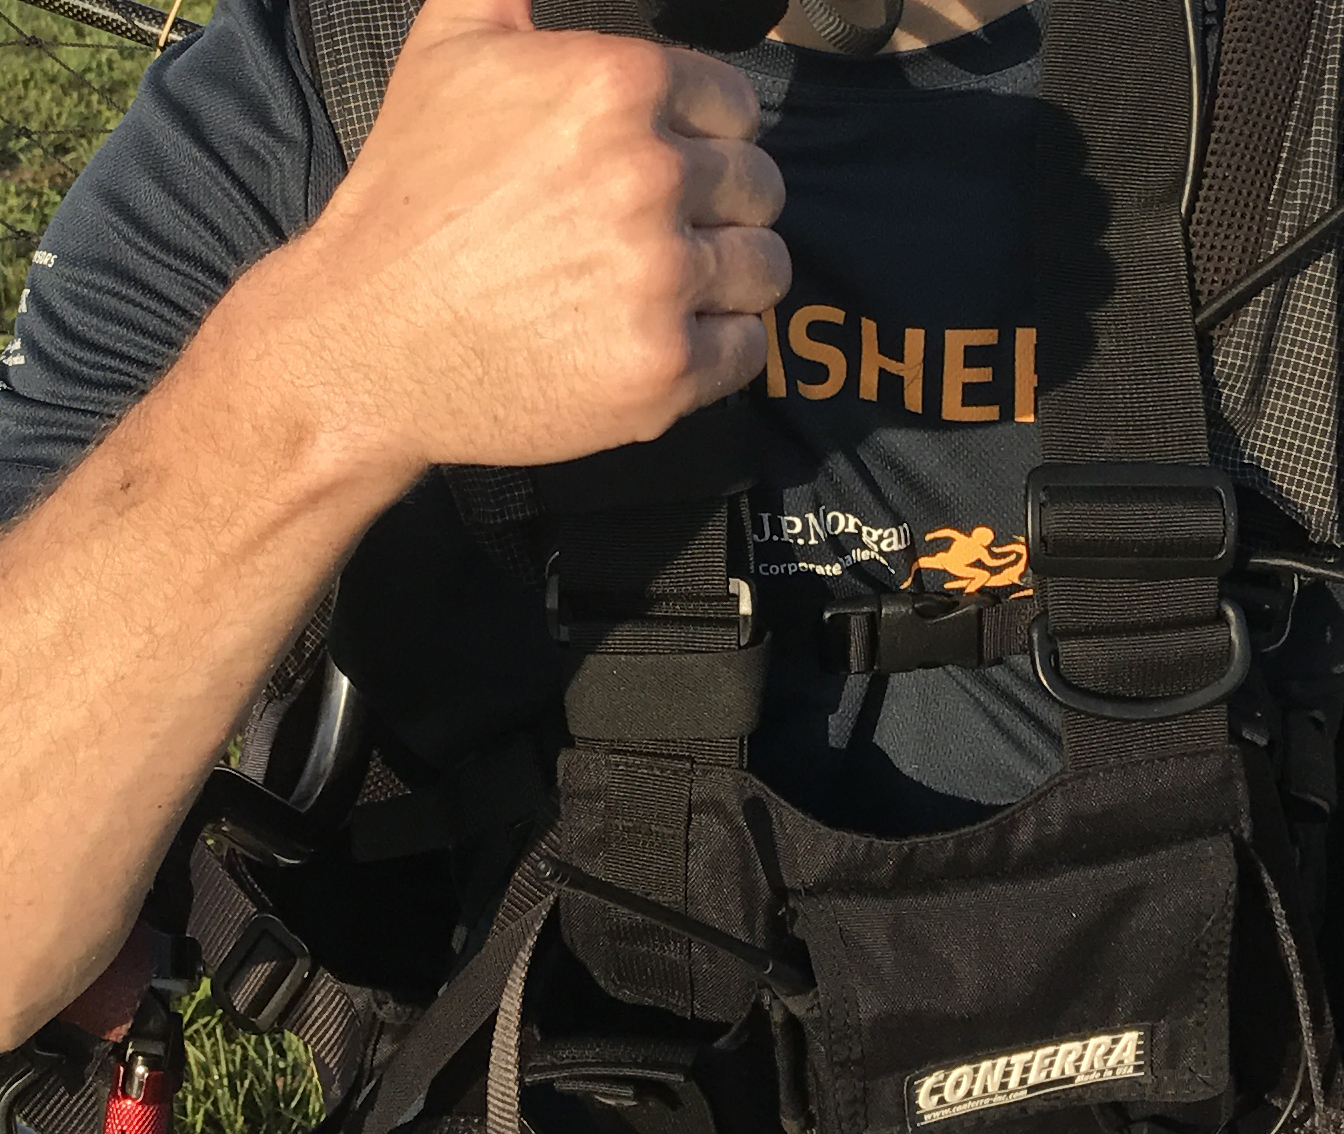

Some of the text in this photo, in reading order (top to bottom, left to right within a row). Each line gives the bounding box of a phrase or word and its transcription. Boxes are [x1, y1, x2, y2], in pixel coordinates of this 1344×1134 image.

[758, 561, 843, 577] Corporate
[918, 1030, 1139, 1111] CONTERRA
[1074, 1065, 1134, 1084] Made in USA
[923, 1089, 1028, 1122] www.conterra-inc.com
